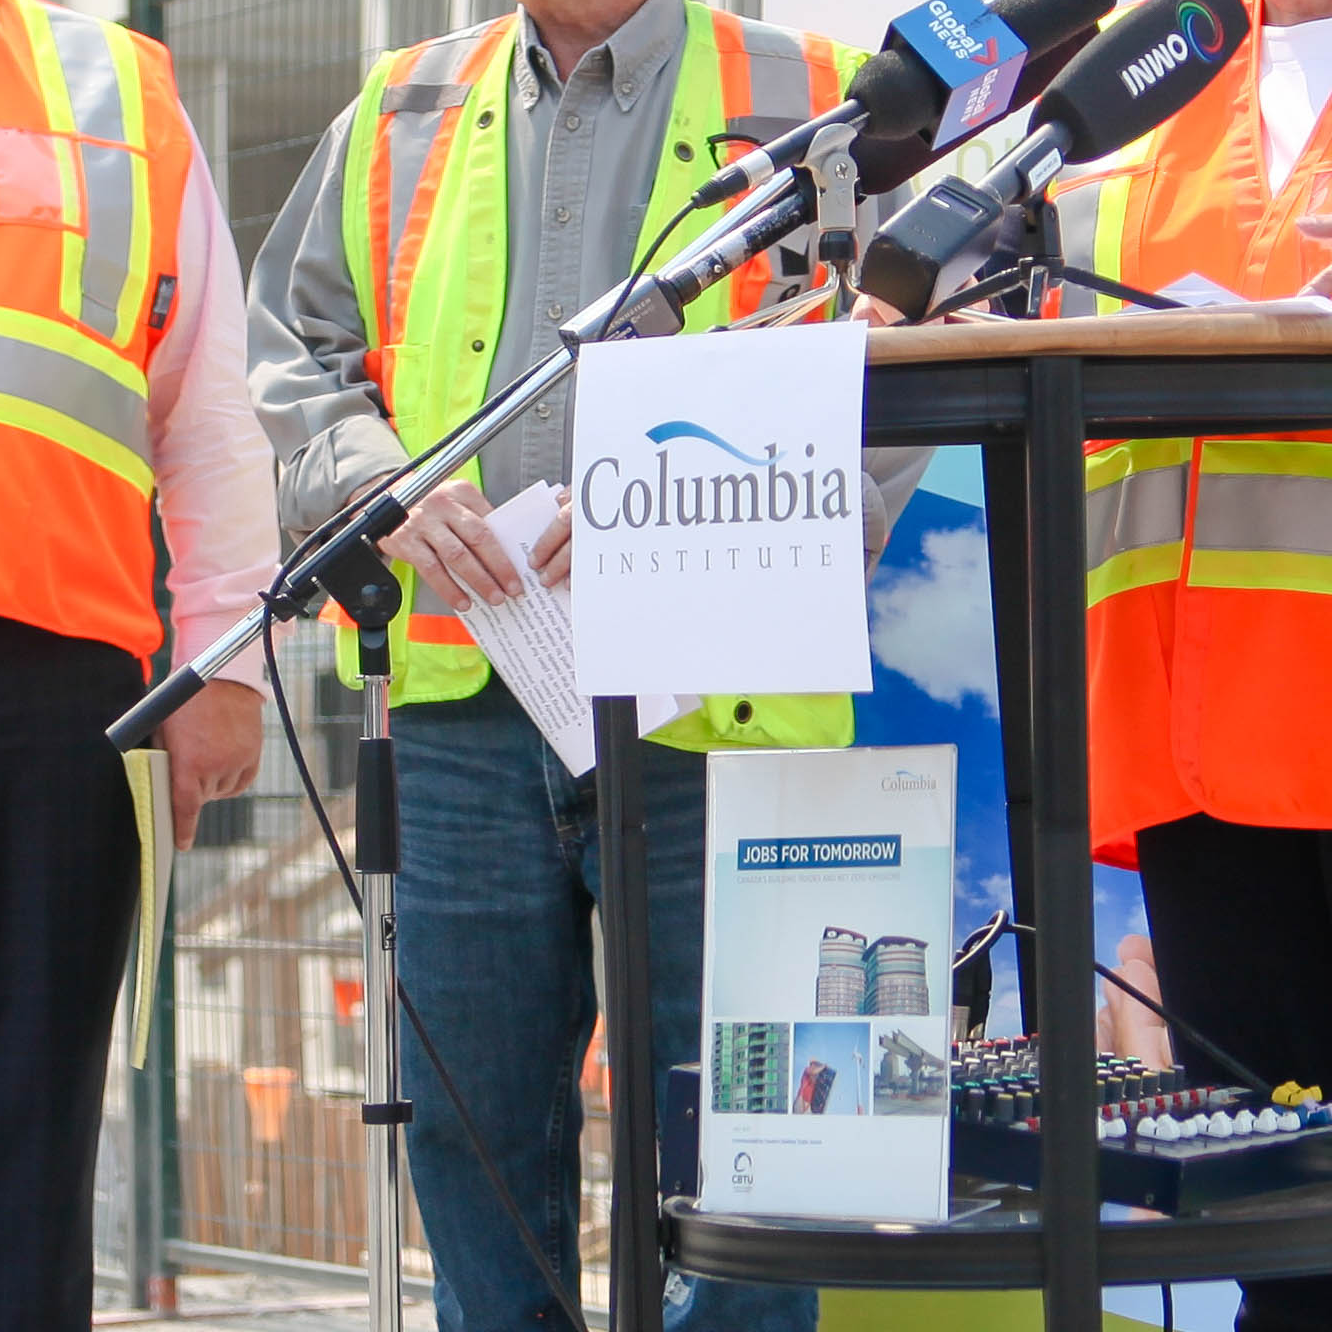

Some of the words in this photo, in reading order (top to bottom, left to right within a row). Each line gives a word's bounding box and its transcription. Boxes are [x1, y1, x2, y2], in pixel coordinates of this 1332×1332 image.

[928, 0, 984, 54] Global
[928, 20, 970, 59] NEWS
[1121, 33, 1189, 97] OMNI
[581, 443, 852, 530] Columbia
[598, 545, 832, 574] INSTITUTE
[881, 773, 937, 792] Columbia
[743, 845, 778, 864] JOBS
[781, 844, 809, 863] FOR
[812, 842, 897, 861] TOMORROW
[731, 1174, 754, 1185] CBTU
